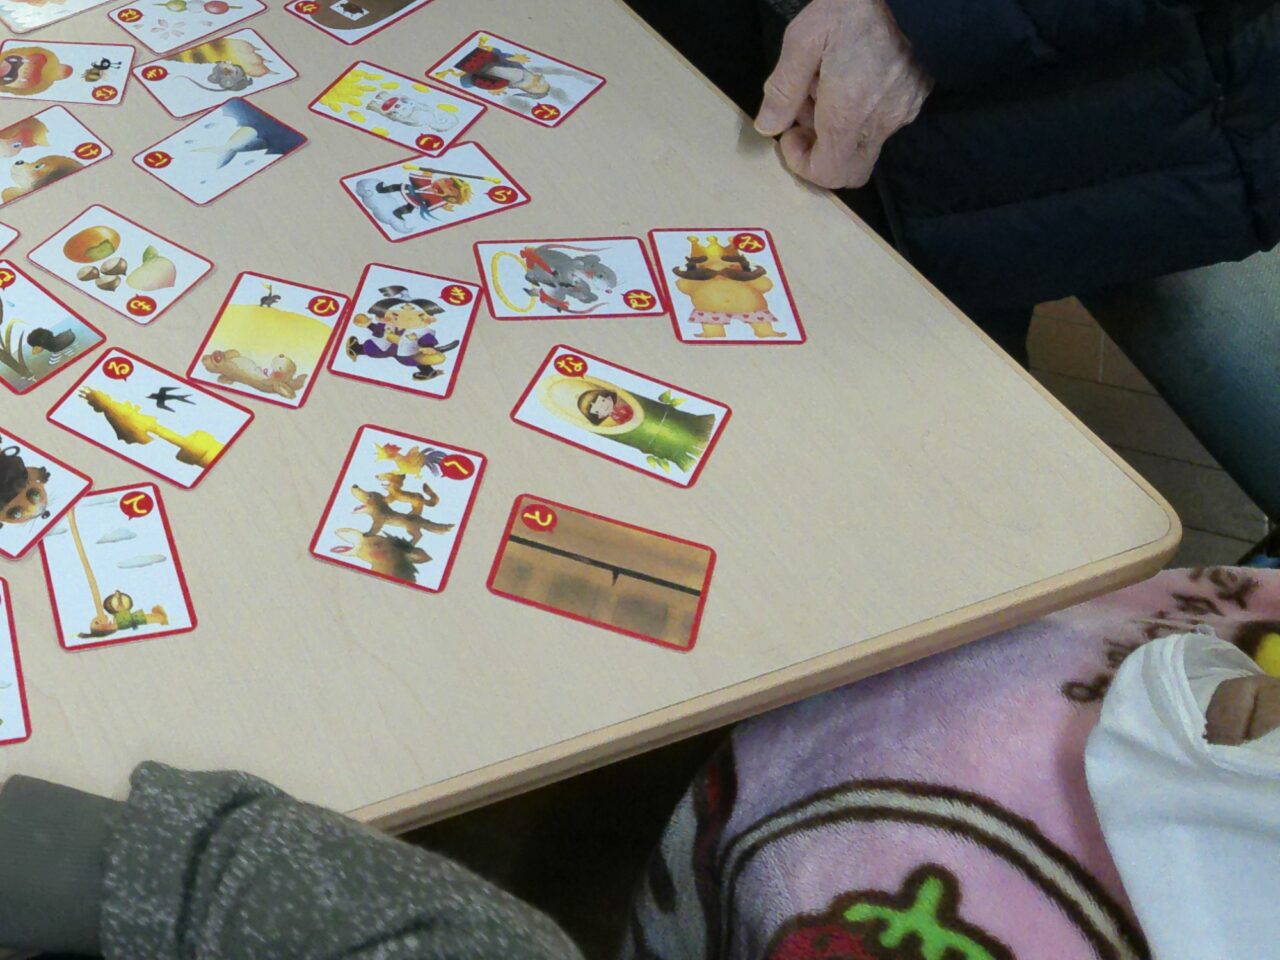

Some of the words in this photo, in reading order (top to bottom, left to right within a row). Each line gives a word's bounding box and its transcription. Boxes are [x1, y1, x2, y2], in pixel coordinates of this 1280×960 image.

[298, 2, 316, 11] か
[120, 9, 139, 21] は
[146, 68, 163, 78] き
[95, 88, 114, 98] な
[534, 105, 557, 118] た
[419, 137, 439, 148] こ
[78, 144, 98, 156] け
[147, 152, 167, 166] に
[493, 190, 511, 201] ら
[738, 235, 762, 249] み
[449, 287, 464, 303] き
[628, 292, 651, 308] ね
[130, 300, 151, 310] も
[313, 298, 334, 313] ひ
[108, 361, 129, 374] る
[556, 357, 582, 372] な
[444, 460, 468, 474] へ
[123, 494, 146, 513] て
[524, 510, 552, 525] と
